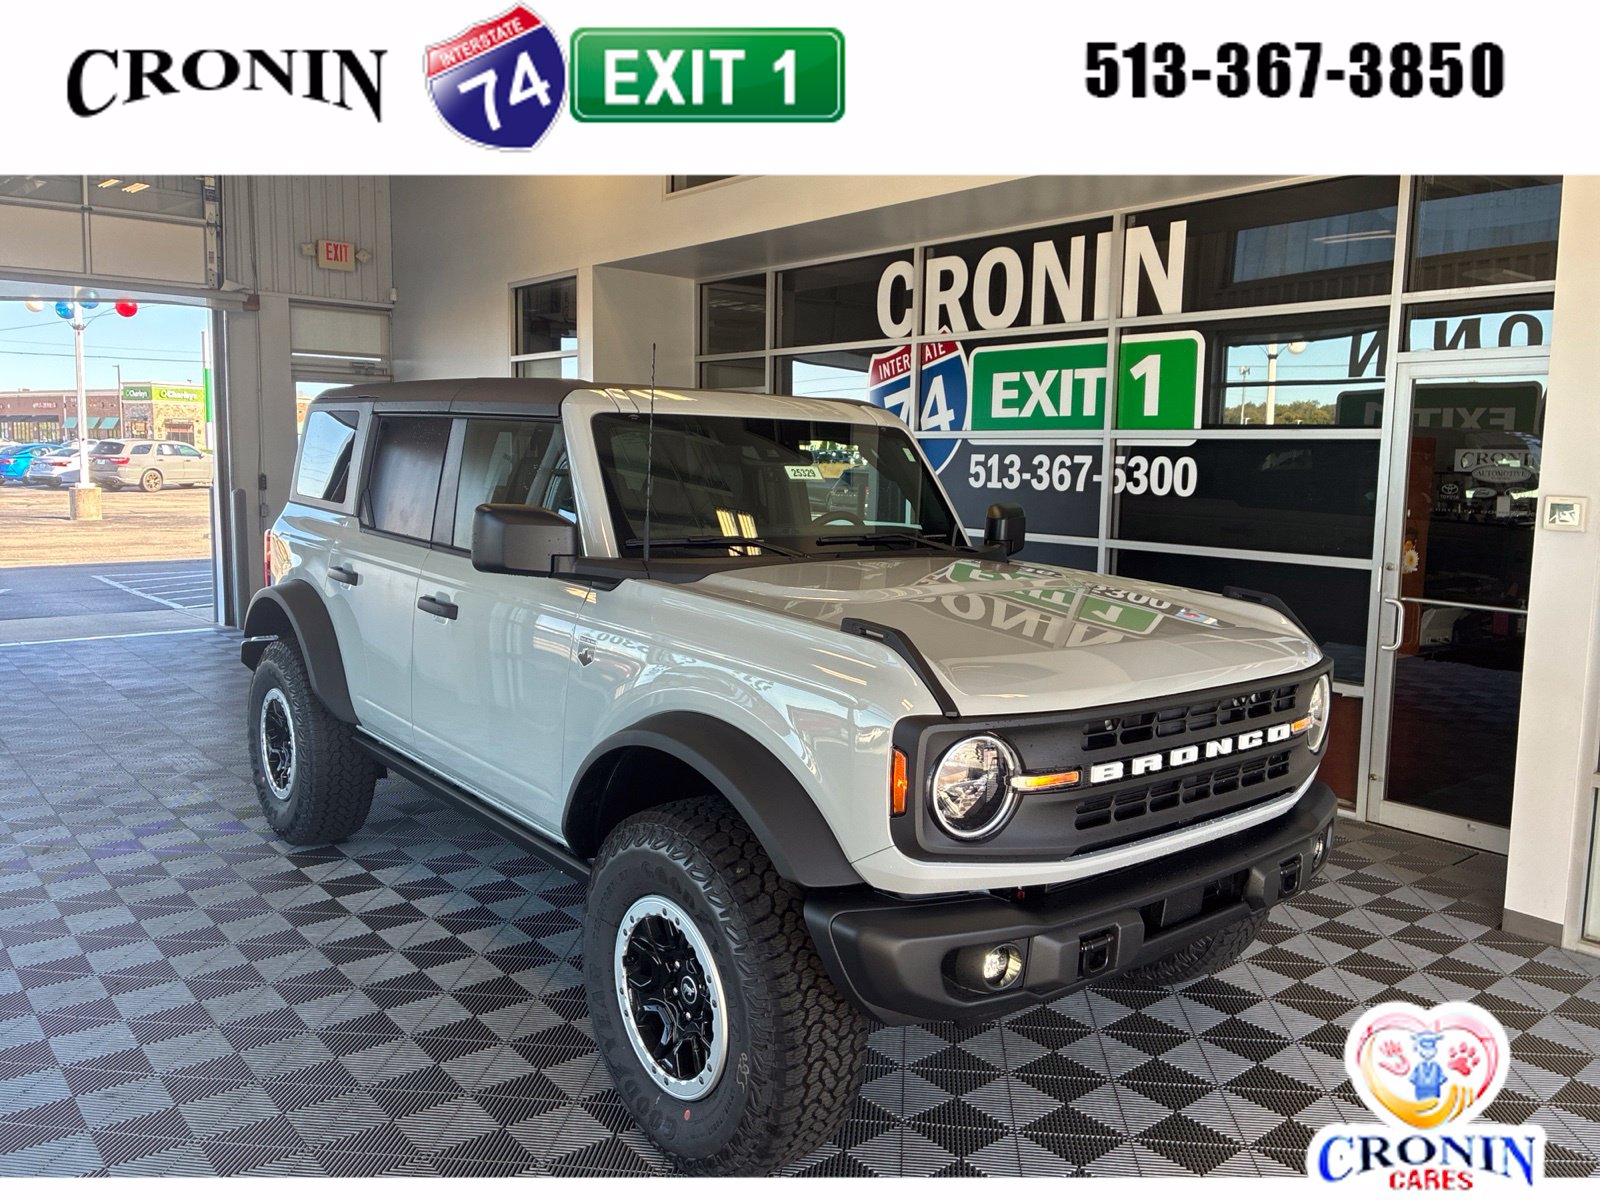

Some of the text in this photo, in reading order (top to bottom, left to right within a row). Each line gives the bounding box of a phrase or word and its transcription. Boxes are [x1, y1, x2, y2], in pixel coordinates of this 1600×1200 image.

[325, 241, 350, 263] EXIT
[876, 220, 1188, 339] CRONIN
[991, 354, 1162, 419] EXIT 1
[790, 468, 817, 478] 25329
[1089, 723, 1292, 784] BRONCO
